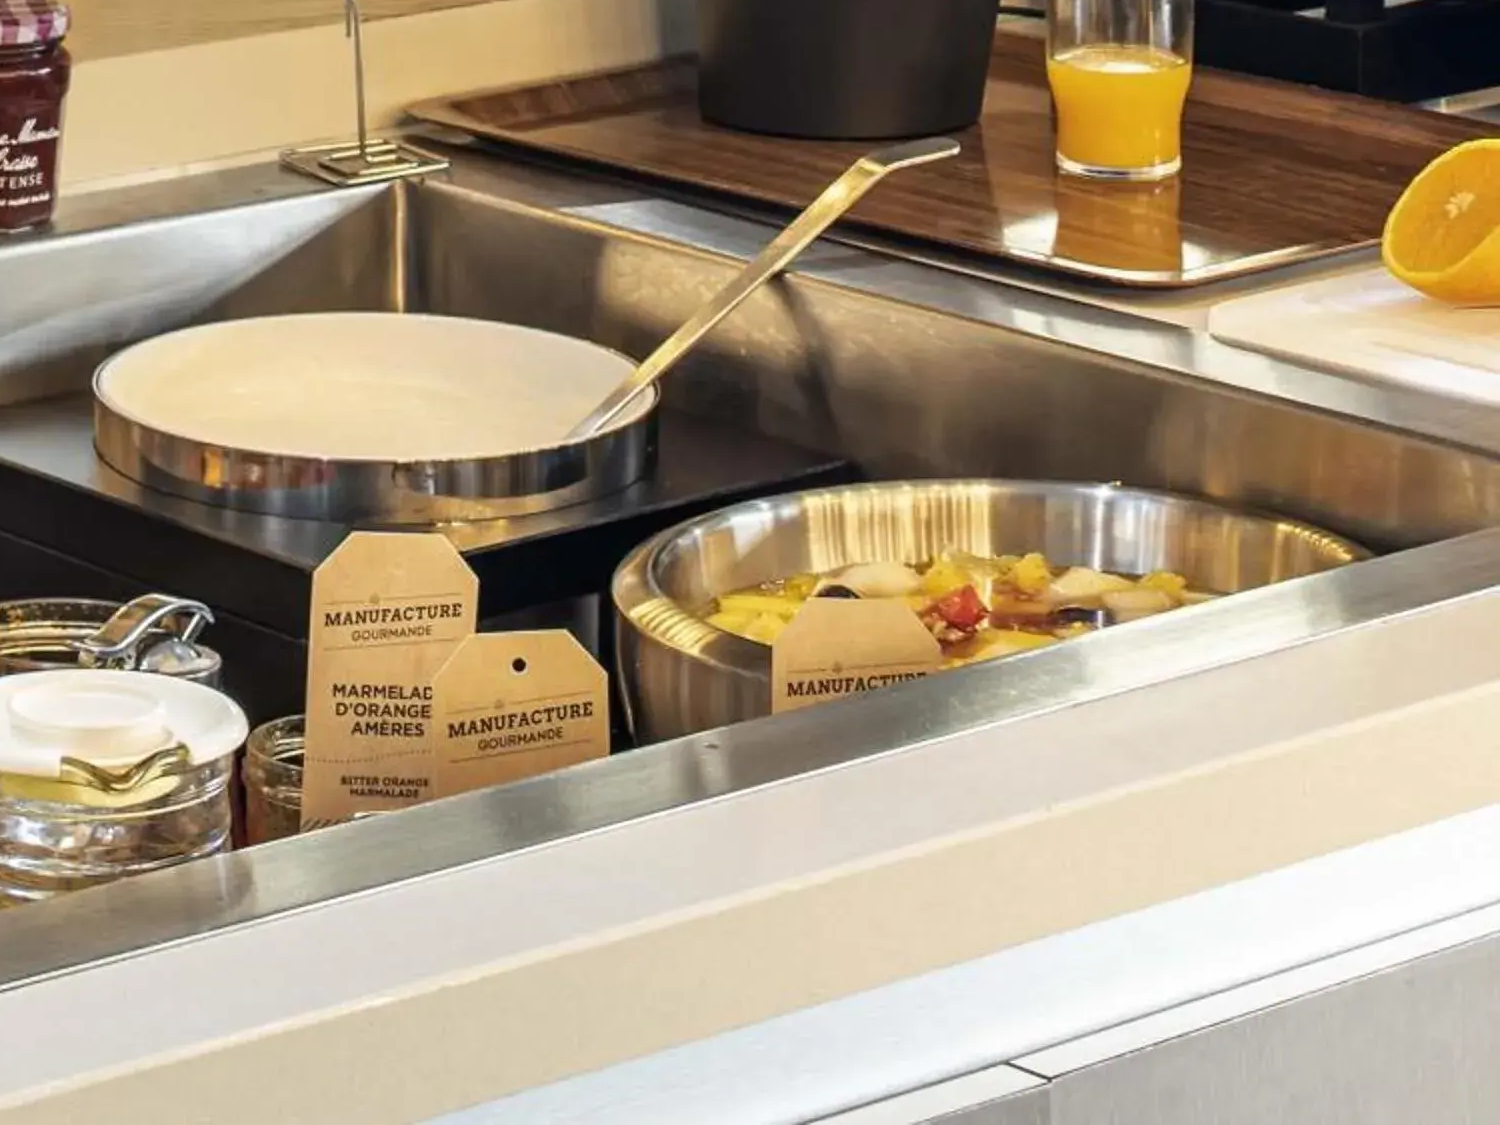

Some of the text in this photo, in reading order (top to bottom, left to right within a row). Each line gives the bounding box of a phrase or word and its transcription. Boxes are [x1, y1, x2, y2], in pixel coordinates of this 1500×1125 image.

[324, 602, 463, 627] MANUFACTURE
[351, 624, 433, 642] GOURMANDE
[332, 682, 434, 701] MARMELAD
[335, 702, 433, 720] D'ORANGE
[447, 701, 594, 740] MANUFACTURE
[350, 718, 426, 738] AMÈRES
[476, 725, 565, 752] GOURMANDE
[340, 775, 429, 788] BITTER ORANGE
[349, 787, 420, 799] MARMALADE
